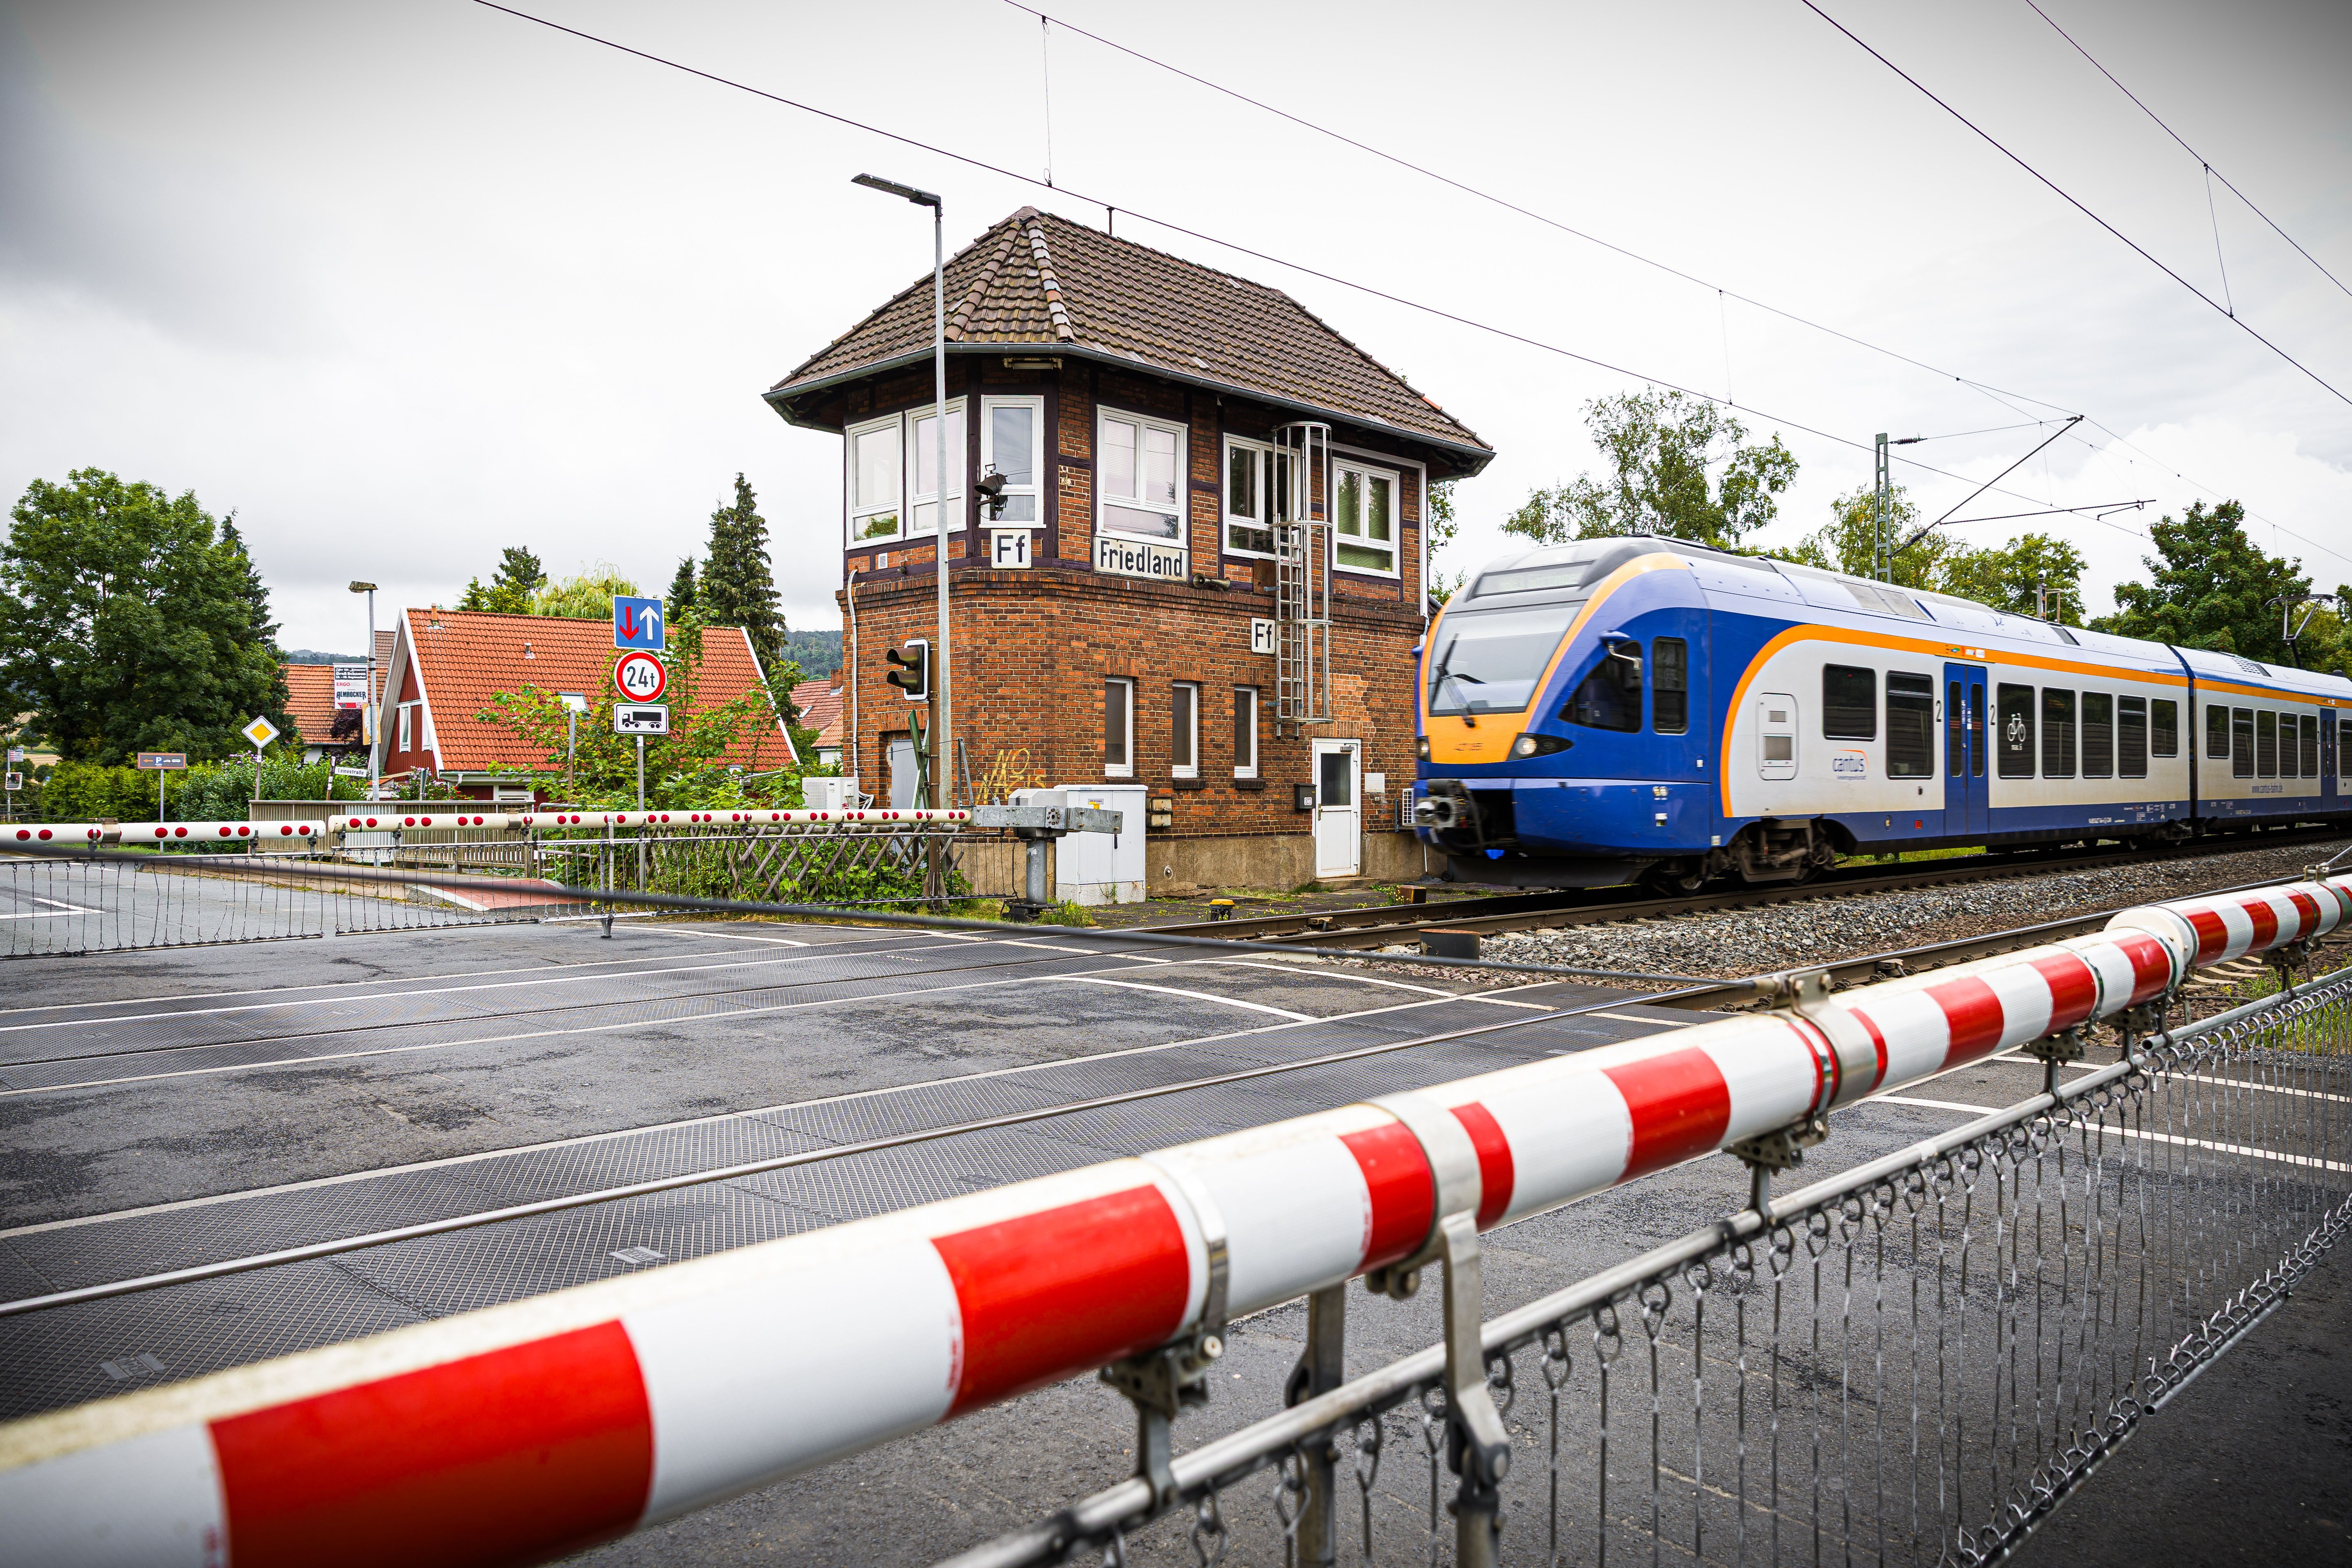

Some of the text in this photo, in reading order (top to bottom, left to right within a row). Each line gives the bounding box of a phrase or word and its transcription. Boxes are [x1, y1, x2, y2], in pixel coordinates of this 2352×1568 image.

[997, 535, 1025, 563] Ff
[1100, 540, 1182, 577] Friedland
[1256, 623, 1272, 648] Ff
[337, 691, 366, 700] ALMROCKER
[1936, 700, 1942, 722] 2
[1990, 704, 1995, 726] 2
[992, 748, 1029, 775] NO
